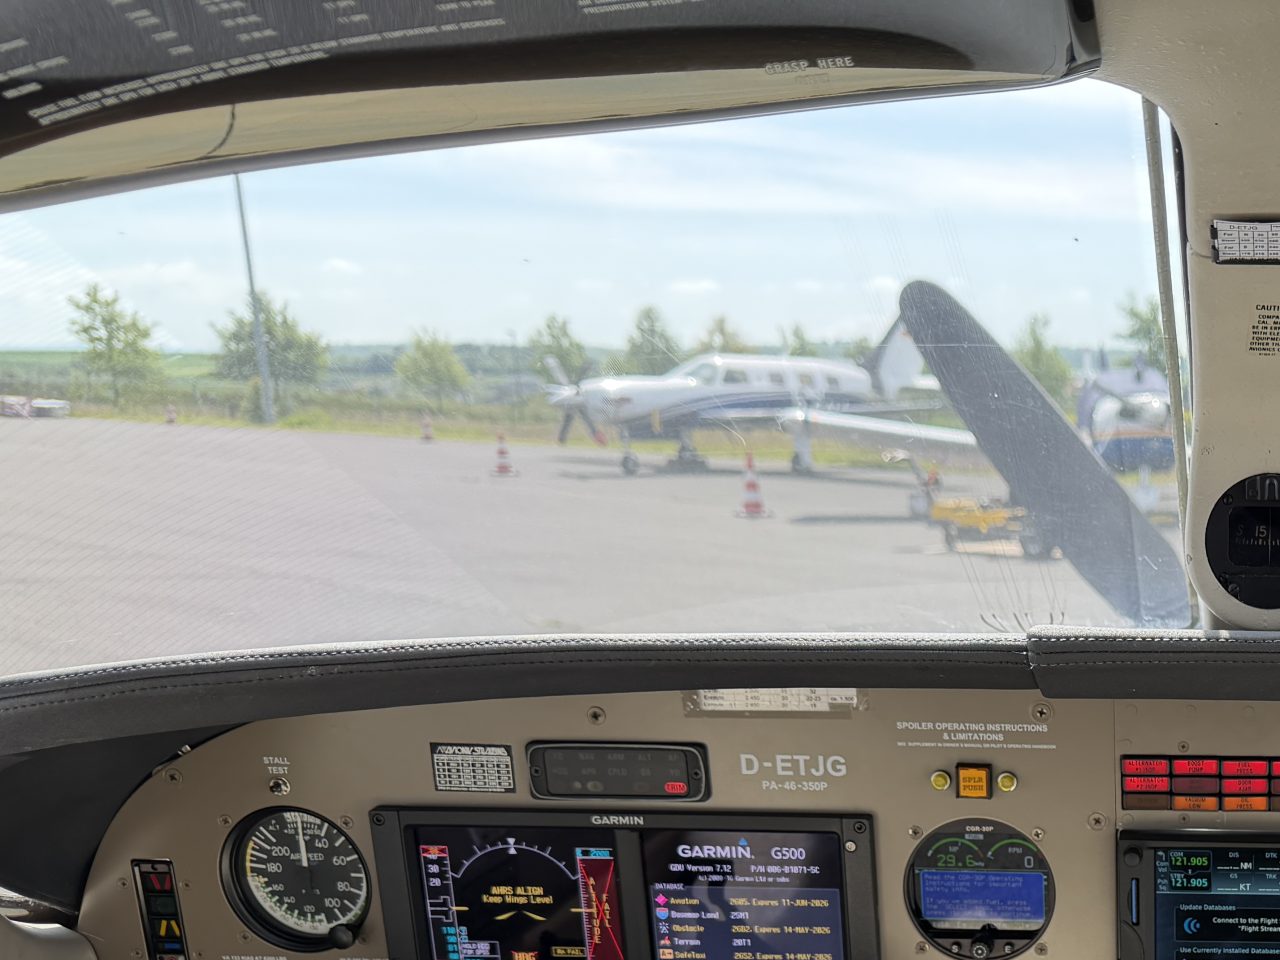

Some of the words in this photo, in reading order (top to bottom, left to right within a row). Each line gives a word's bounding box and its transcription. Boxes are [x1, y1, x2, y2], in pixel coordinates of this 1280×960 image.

[765, 61, 809, 75] GRASP
[817, 57, 854, 69] HERE
[1256, 526, 1267, 537] 15
[896, 722, 934, 731] SPOILER
[935, 722, 985, 732] OPERATING
[986, 724, 1048, 733] INSTRUCTIONS
[951, 733, 1004, 741] LIMITATIONS
[263, 757, 290, 765] STALL
[740, 754, 847, 777] D-ETJG
[268, 766, 288, 774] TEST
[962, 776, 983, 784] SPLR
[762, 781, 828, 792] PA-46-350P
[962, 784, 984, 792] PUSH
[591, 815, 644, 826] GARMIN
[272, 846, 290, 856] 200
[677, 845, 752, 859] GARMIN
[771, 847, 806, 860] G500
[1171, 857, 1208, 866] 121.905
[686, 864, 714, 872] Version
[1171, 878, 1208, 887] 121.905
[491, 886, 514, 895] AHRS
[517, 887, 543, 895] ALIGN
[482, 895, 503, 904] Keep
[506, 896, 528, 904] Wings
[531, 896, 553, 904] Level
[782, 899, 829, 907] 11-JUN-2026
[785, 953, 832, 960] 14-MAY-2026
